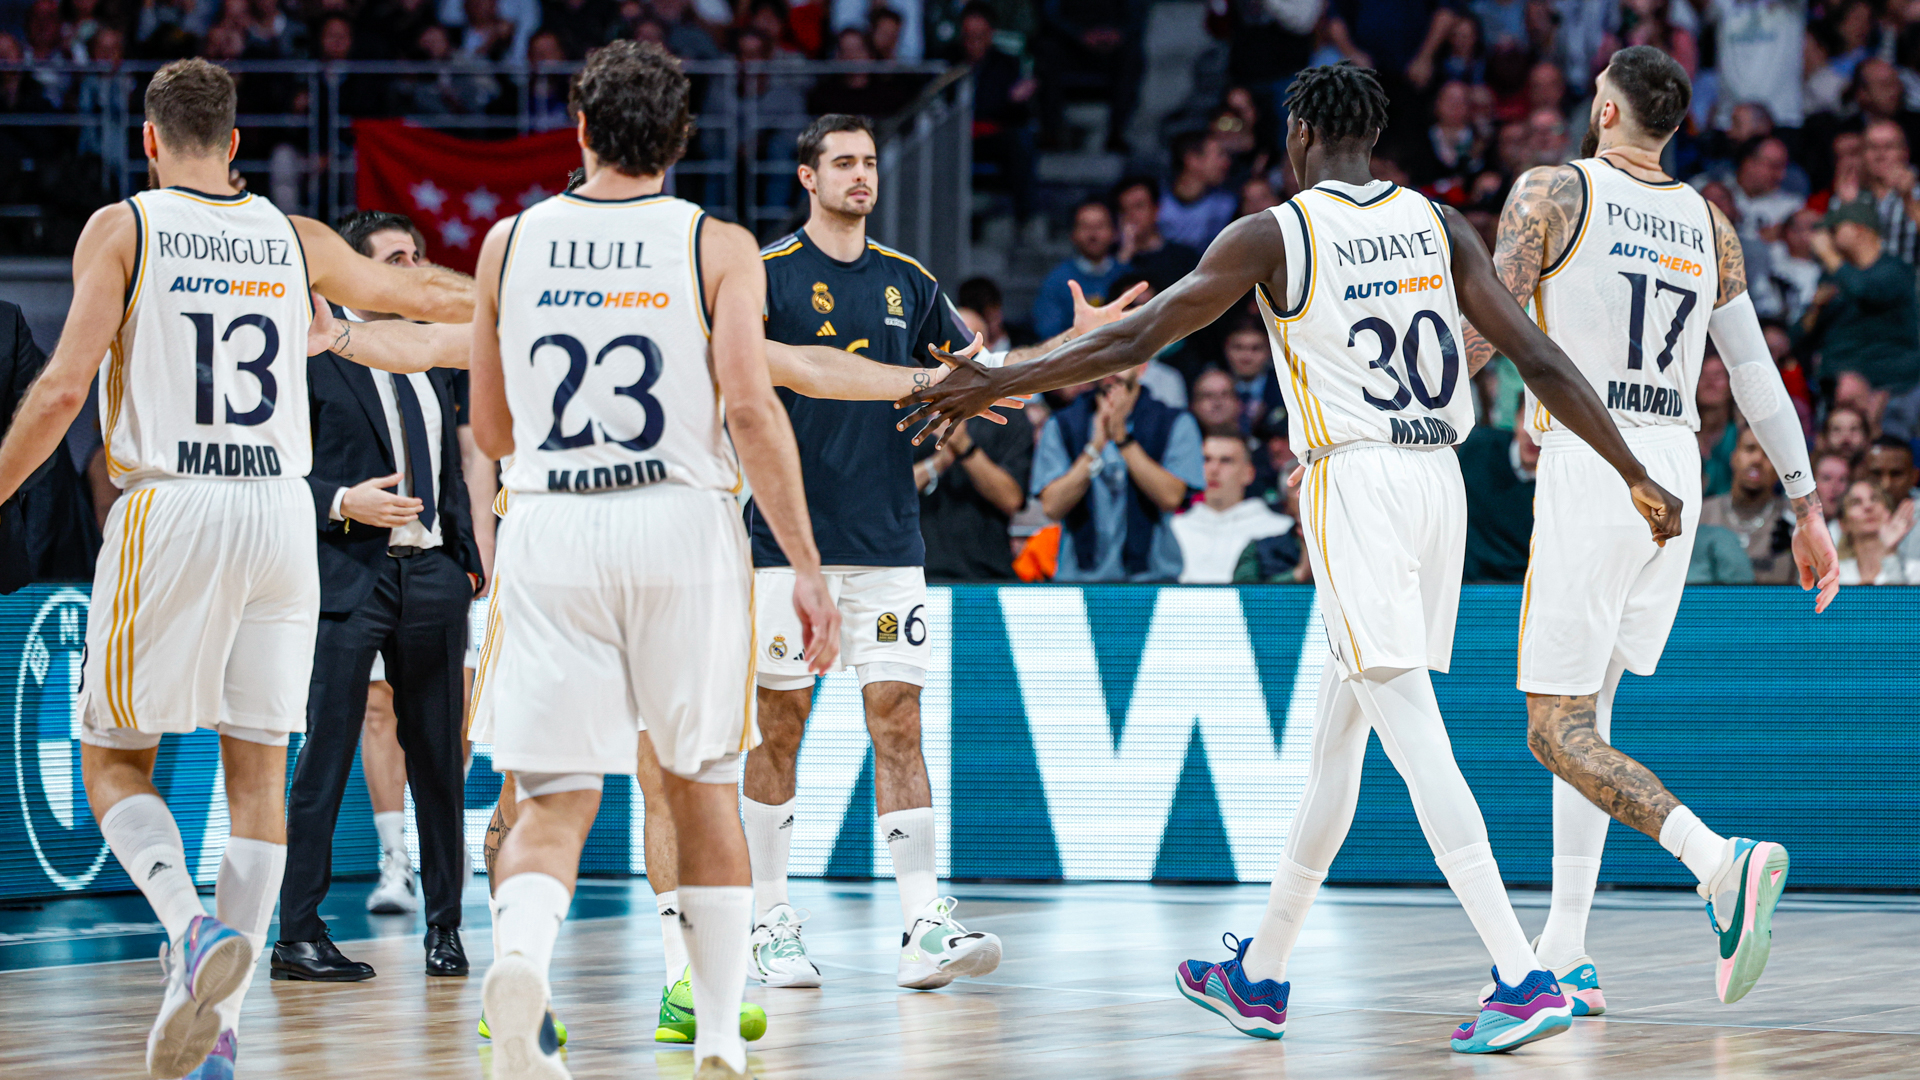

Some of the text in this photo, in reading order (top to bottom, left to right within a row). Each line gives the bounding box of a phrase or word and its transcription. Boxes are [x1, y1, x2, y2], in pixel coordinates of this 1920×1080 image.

[1605, 202, 1705, 254] POIRIER
[157, 230, 292, 266] RODRÍGUEZ
[549, 240, 653, 270] LLULL
[1332, 229, 1438, 267] NDIAYE
[1608, 242, 1703, 277] AUTOHERO
[169, 276, 286, 299] AUTOHERO
[536, 290, 670, 309] AUTOHERO
[1344, 274, 1443, 301] AUTOHERO
[1617, 271, 1698, 374] 17
[180, 312, 280, 427] 13
[1347, 309, 1460, 411] 30
[529, 333, 666, 453] 23
[1607, 380, 1684, 418] MADRID
[1389, 416, 1459, 445] MADRID
[176, 440, 282, 478] MADRID
[547, 459, 668, 493] MADRID
[904, 604, 926, 646] 6
